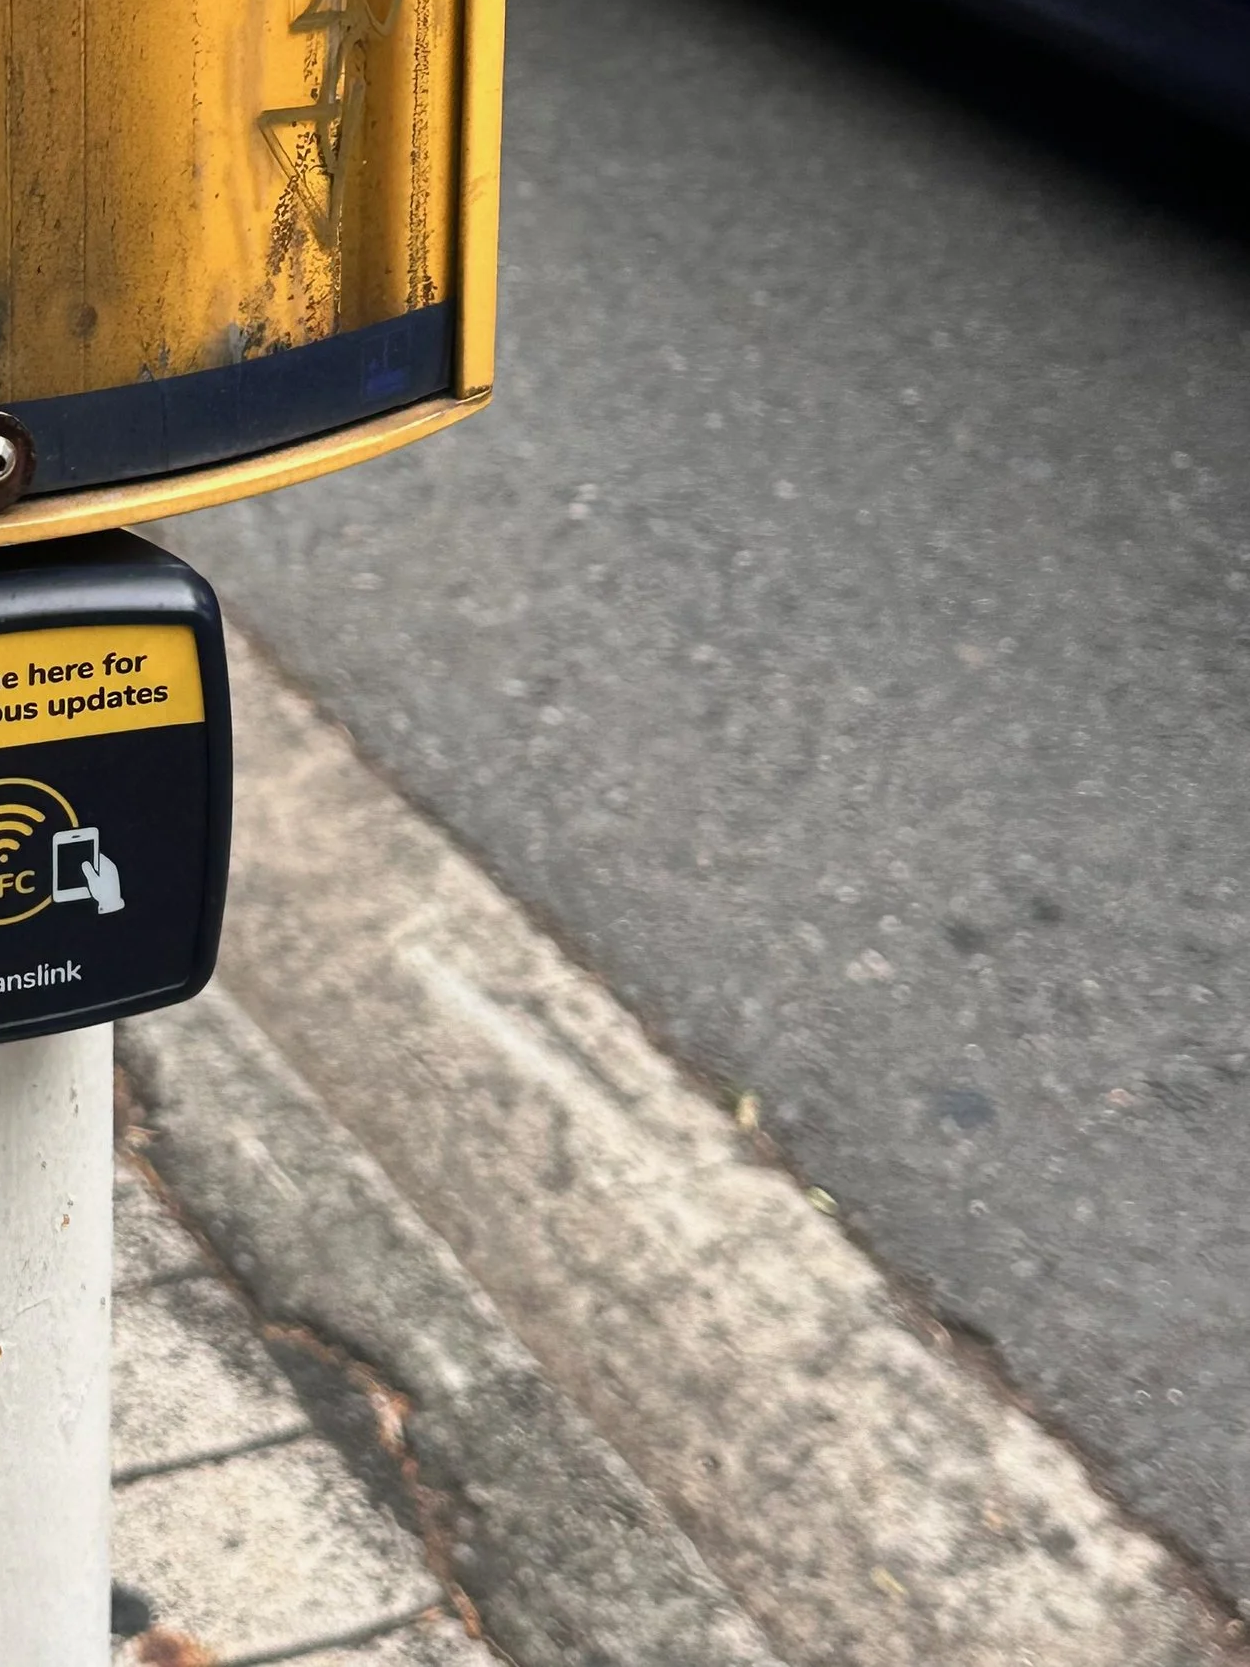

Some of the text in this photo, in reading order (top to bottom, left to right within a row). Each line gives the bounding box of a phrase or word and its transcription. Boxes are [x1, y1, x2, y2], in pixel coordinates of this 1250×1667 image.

[28, 663, 94, 686] here
[102, 652, 148, 676] for
[47, 684, 169, 720] updates
